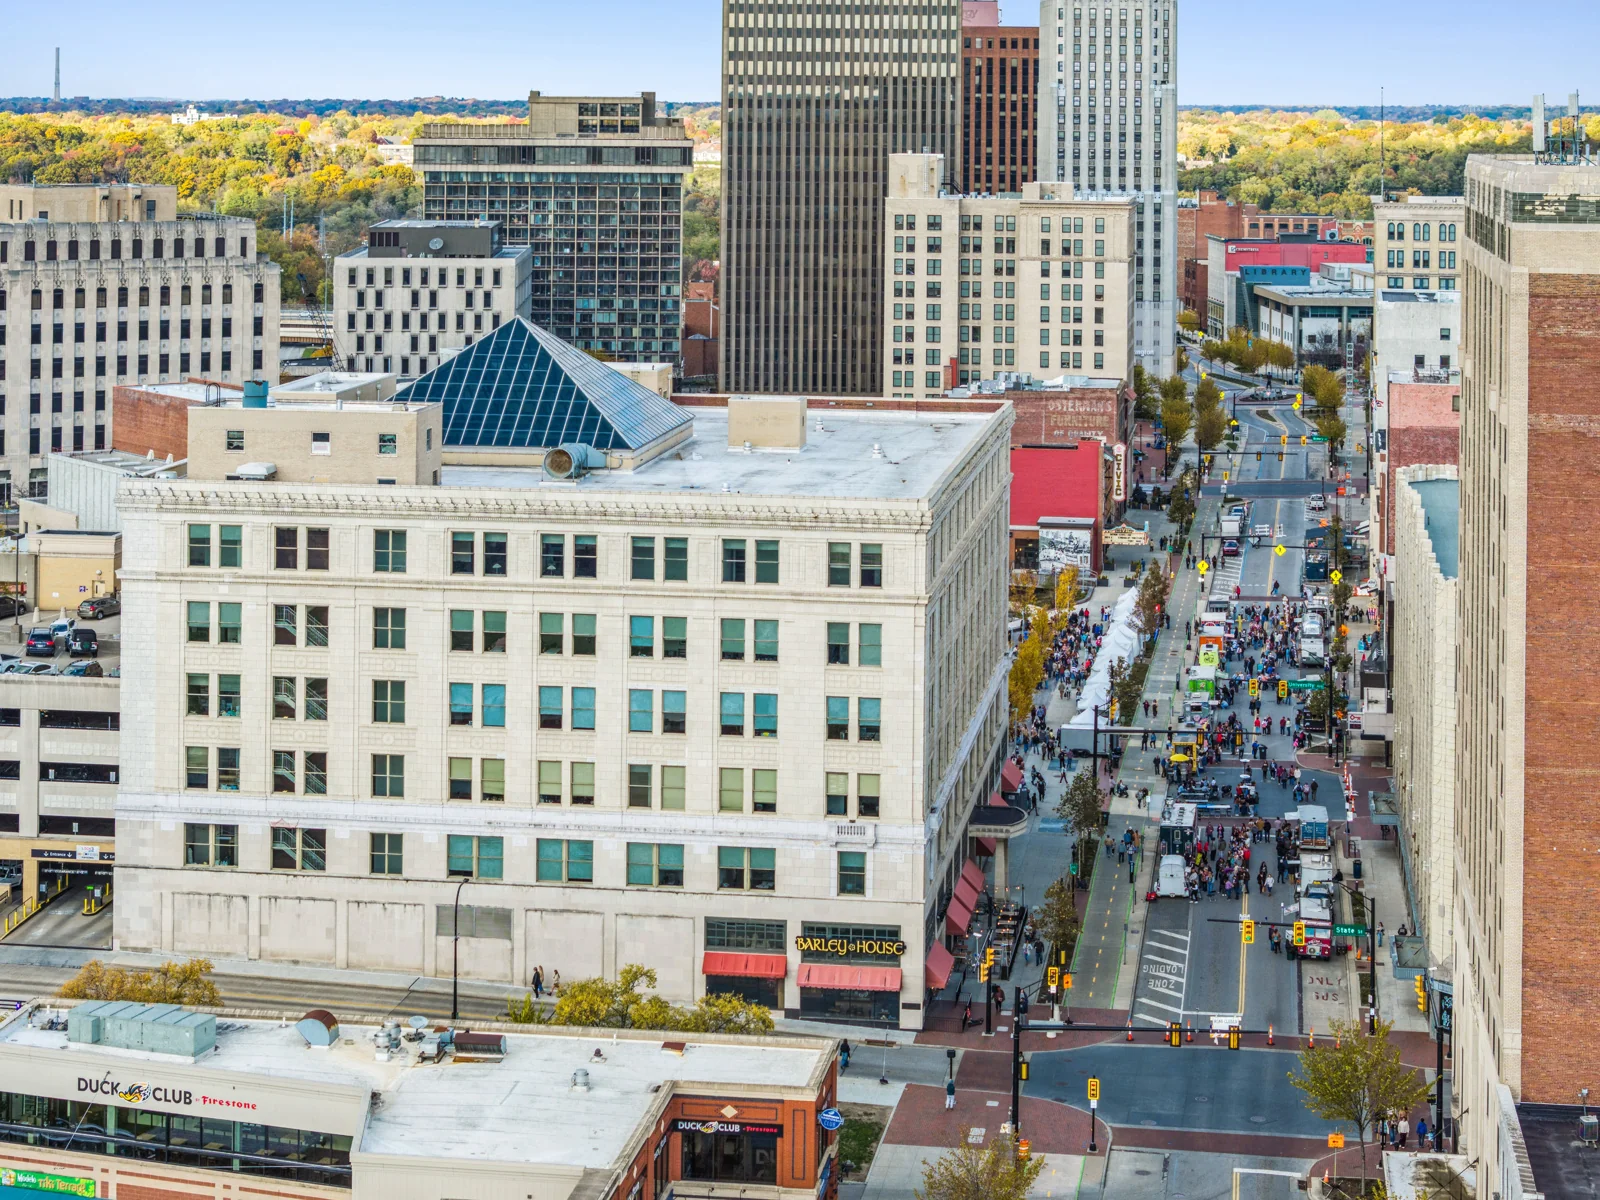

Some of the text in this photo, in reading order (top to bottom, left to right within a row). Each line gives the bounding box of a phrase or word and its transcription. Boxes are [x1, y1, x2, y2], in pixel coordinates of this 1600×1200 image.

[1050, 414, 1110, 427] FURNITURE
[797, 937, 904, 956] BARLEY HOUSE
[1142, 964, 1184, 974] LOADING
[1148, 979, 1175, 989] ZONE
[77, 1077, 121, 1096] DUCK
[152, 1087, 192, 1105] CLUB
[201, 1095, 257, 1110] Firestone
[678, 1121, 702, 1130] DUCK
[718, 1124, 740, 1132] CLUB
[17, 1173, 36, 1184] Modelo
